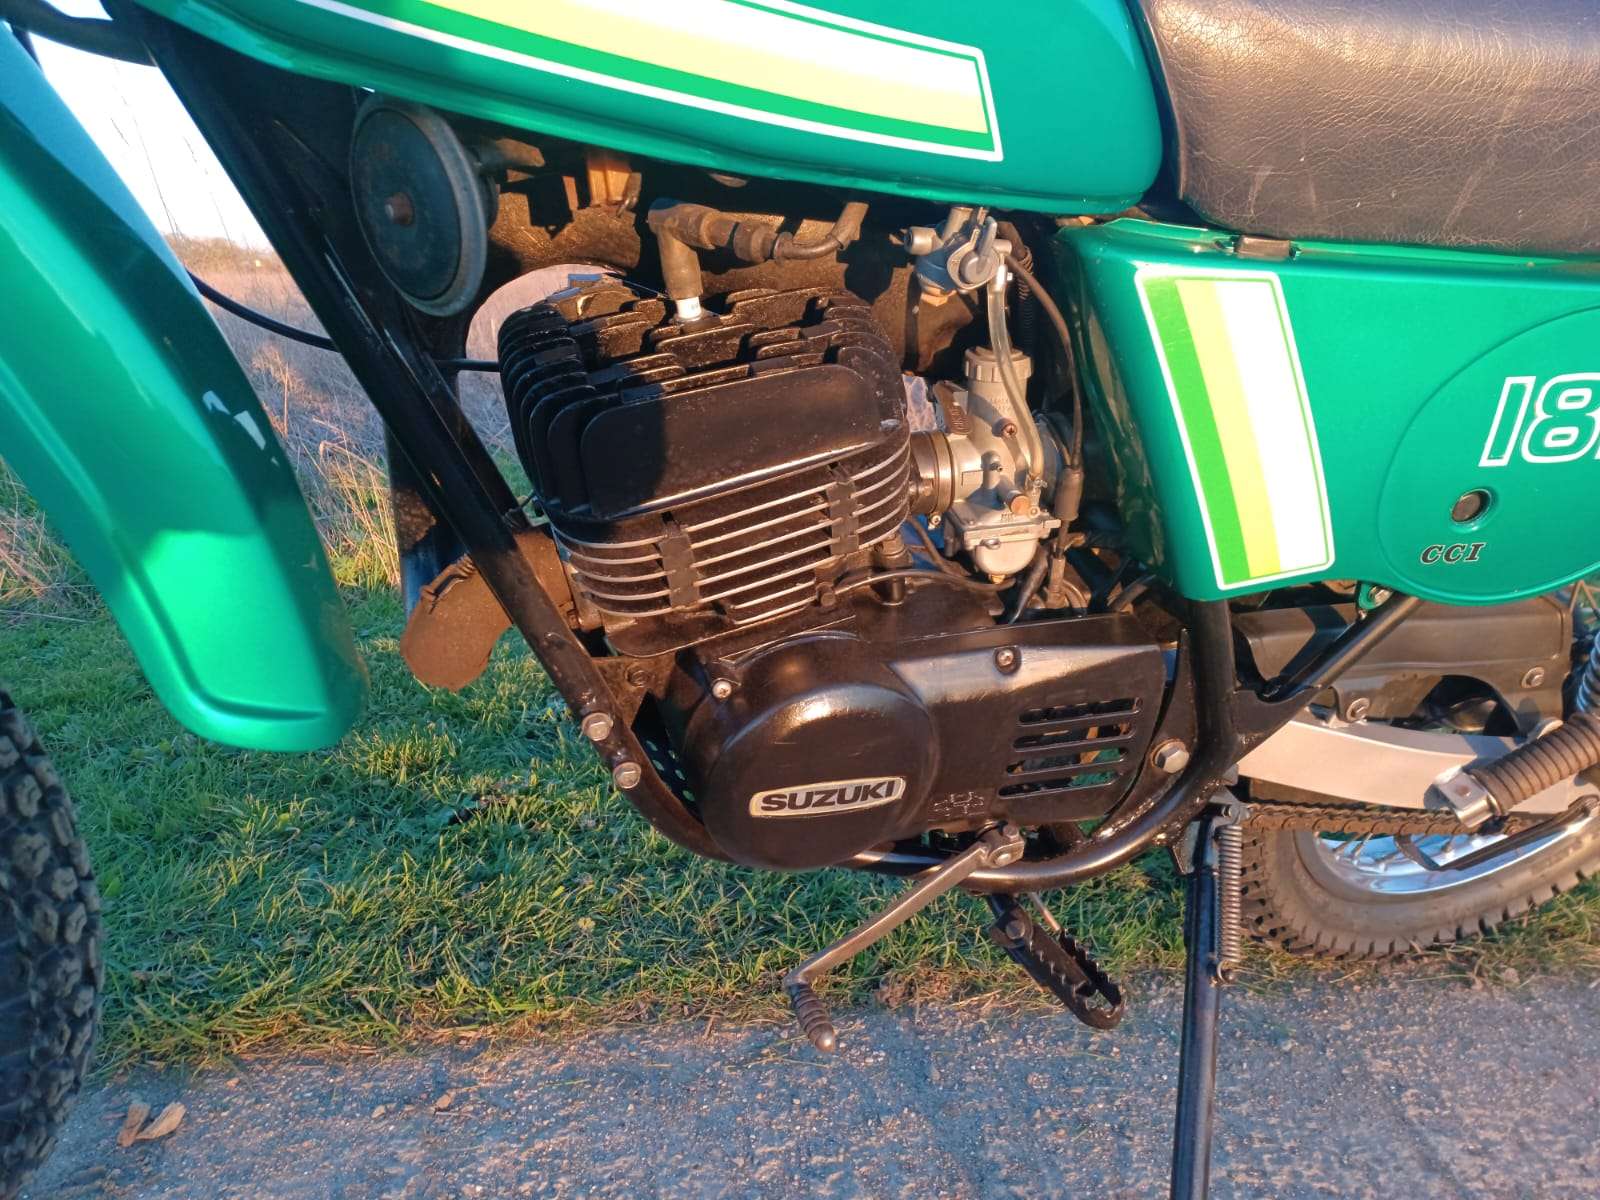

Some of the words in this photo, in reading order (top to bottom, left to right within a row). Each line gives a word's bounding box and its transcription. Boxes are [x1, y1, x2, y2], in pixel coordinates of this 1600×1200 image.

[1478, 372, 1600, 467] 18
[1420, 542, 1486, 564] CCI
[760, 780, 896, 812] SUZUKI
